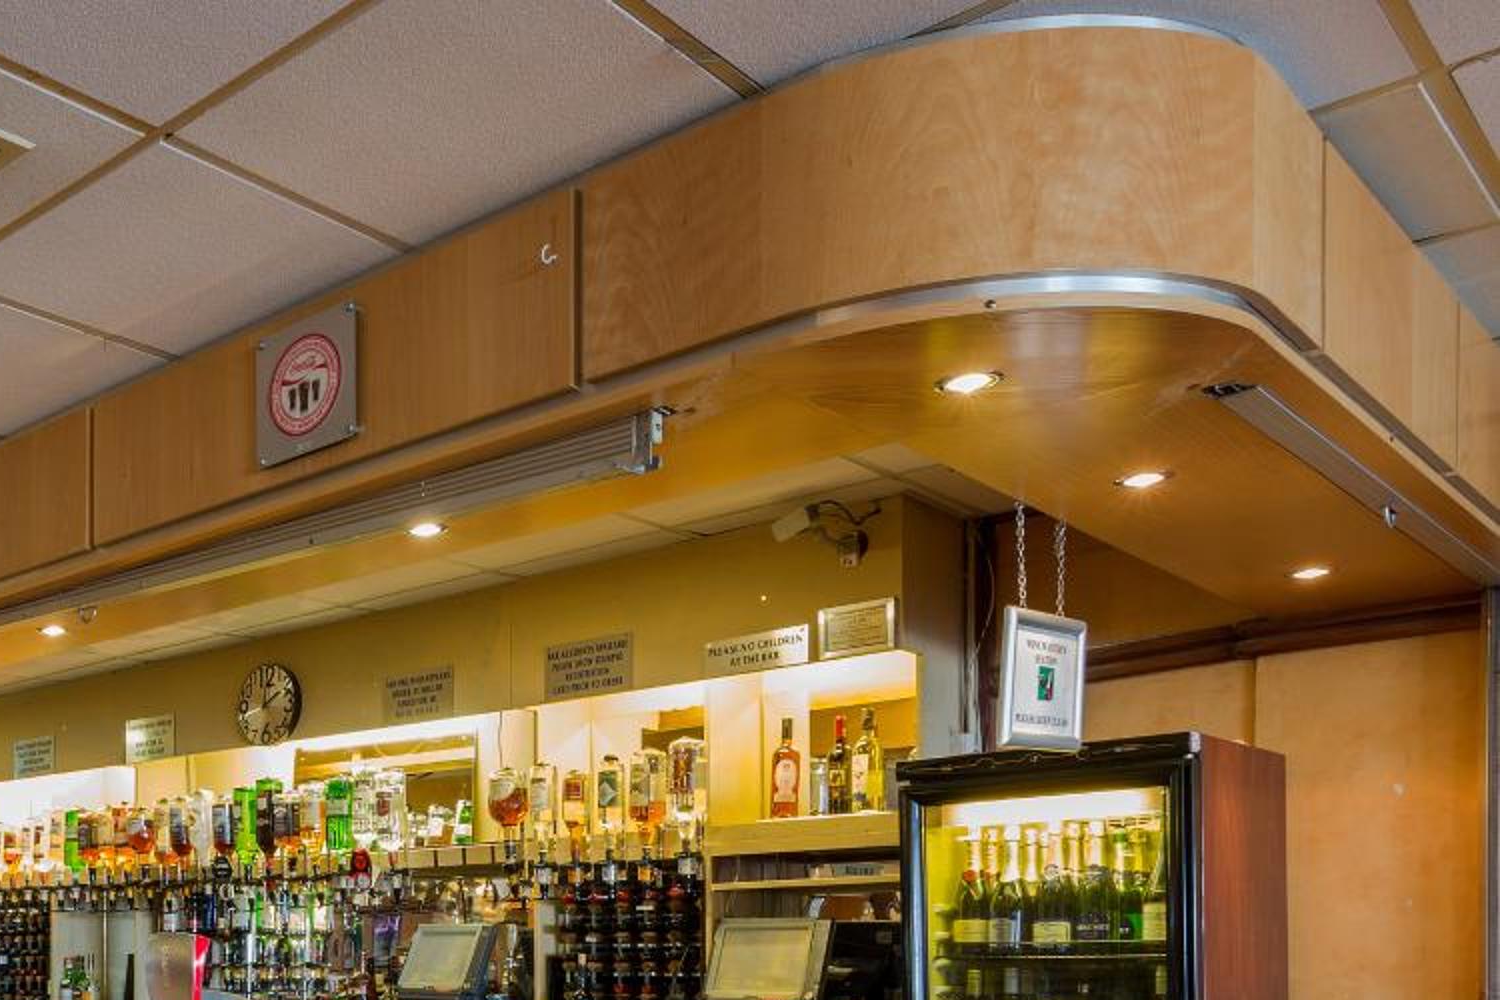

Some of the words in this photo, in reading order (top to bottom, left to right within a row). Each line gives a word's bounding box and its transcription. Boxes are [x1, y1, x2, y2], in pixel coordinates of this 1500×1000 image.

[708, 644, 738, 657] PLEASE
[741, 641, 755, 652] NO
[758, 633, 803, 649] CHILDREN
[743, 653, 760, 665] THE
[761, 651, 779, 661] BAR
